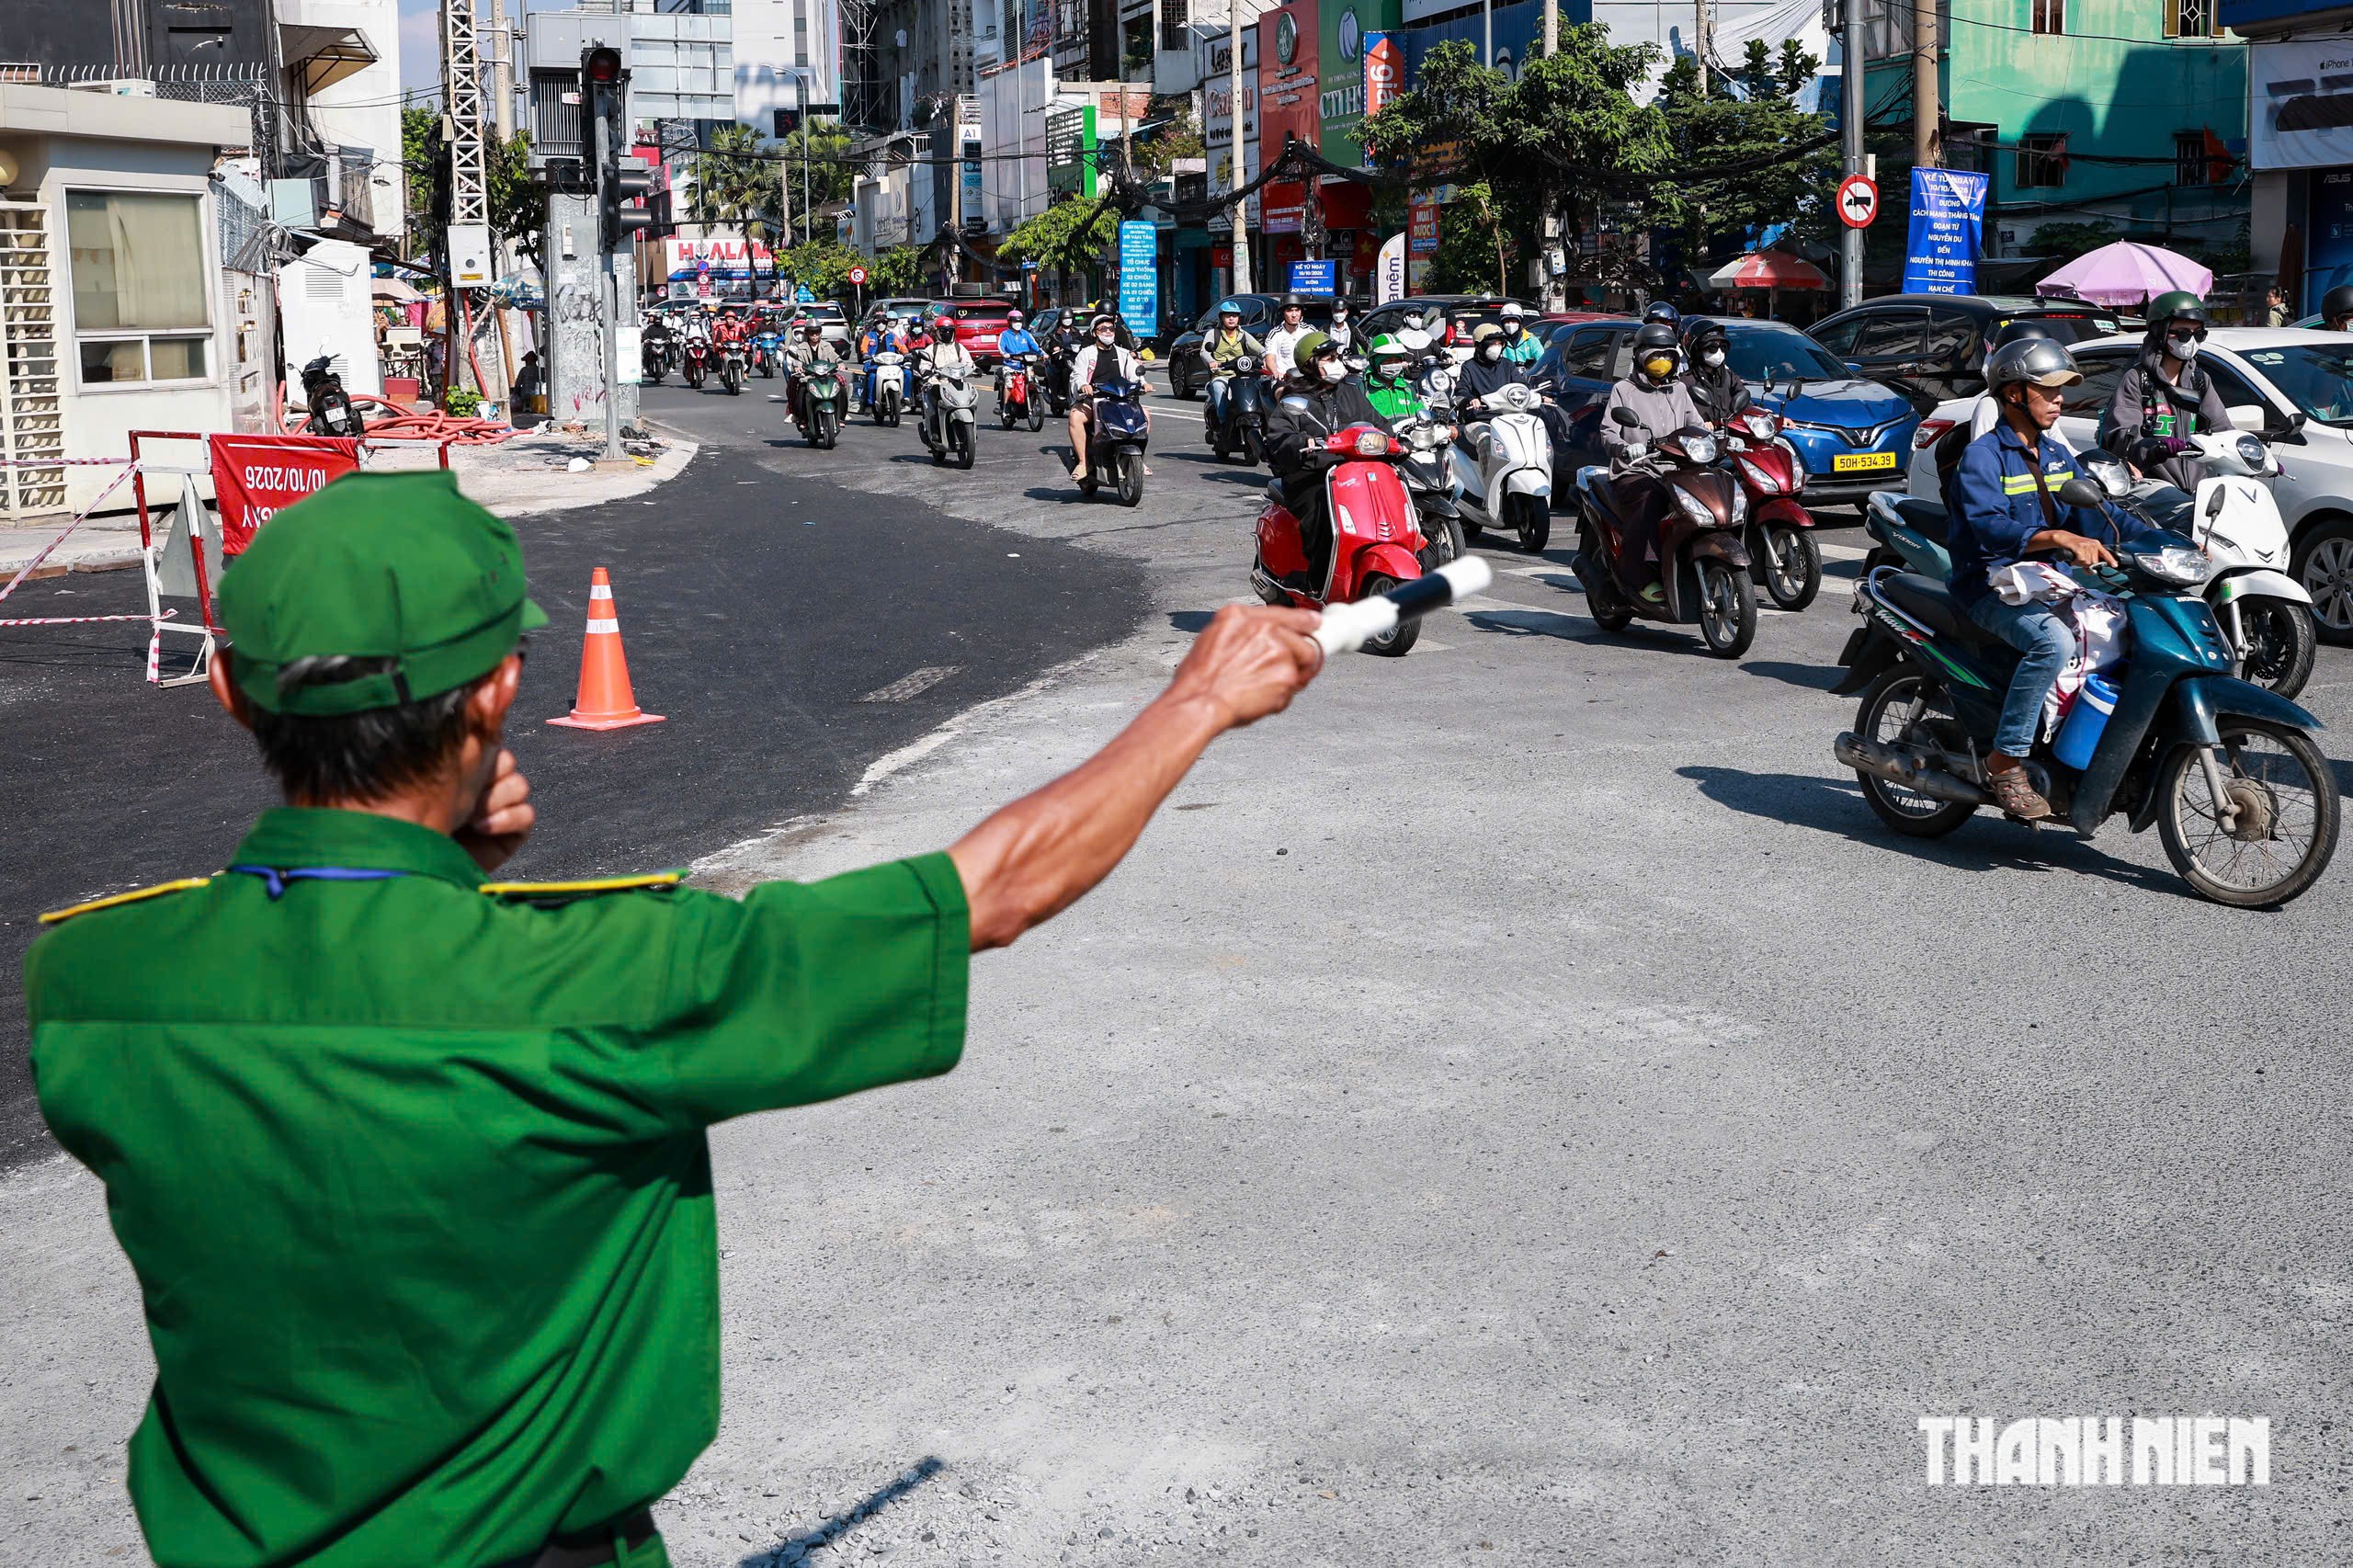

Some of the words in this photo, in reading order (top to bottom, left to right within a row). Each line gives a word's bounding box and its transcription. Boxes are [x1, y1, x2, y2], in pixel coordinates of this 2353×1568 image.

[2325, 60, 2349, 69] iPhone
[2324, 173, 2352, 184] ASUS
[1913, 209, 1928, 217] CÁCH
[1933, 222, 1950, 232] ĐOẠN
[1927, 233, 1953, 243] NGUYỄN
[1937, 244, 1950, 254] ĐẾN
[1909, 255, 1934, 265] NGUYỄN
[1938, 269, 1955, 278] CÔNG
[1941, 284, 1955, 293] CHẾ
[1893, 531, 1922, 550] VISION
